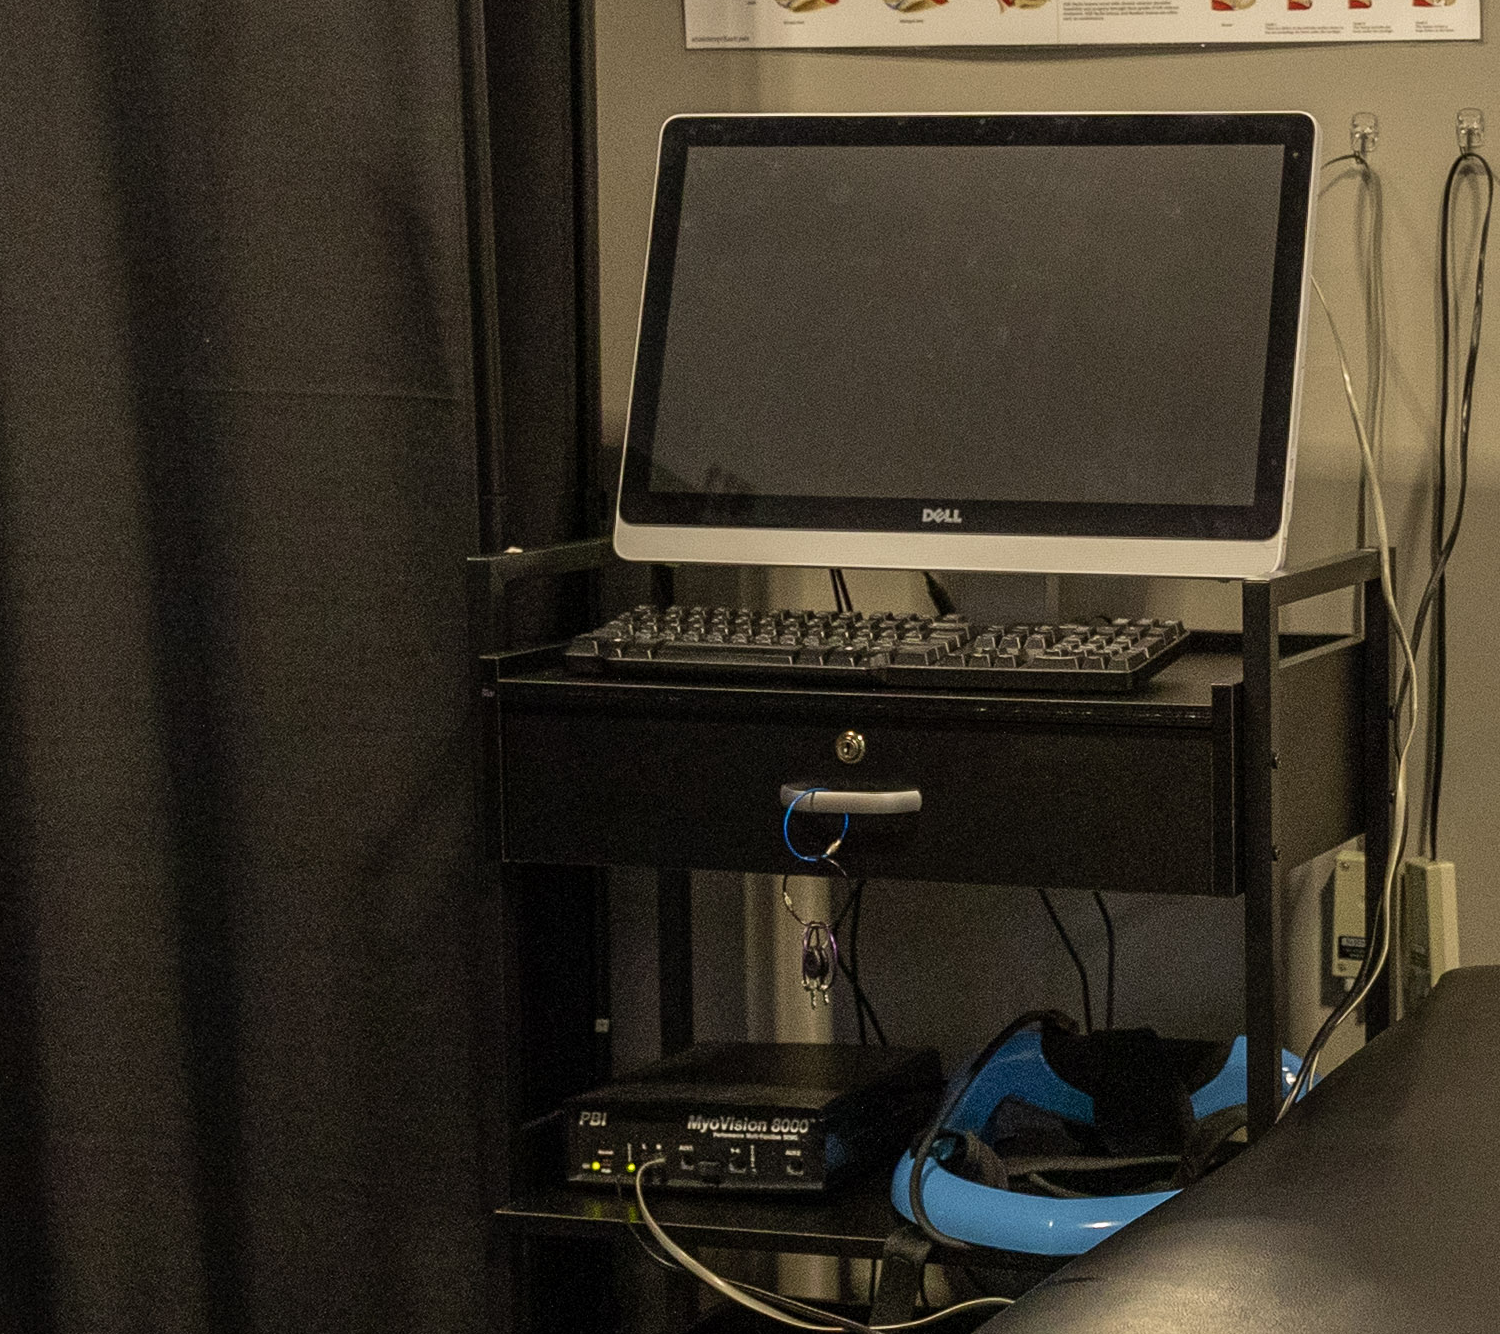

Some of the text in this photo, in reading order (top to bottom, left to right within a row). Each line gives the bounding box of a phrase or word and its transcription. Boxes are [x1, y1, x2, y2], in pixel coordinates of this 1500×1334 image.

[922, 508, 962, 523] DELL
[579, 1112, 607, 1126] PBI
[687, 1115, 810, 1133] MyoVision 8000
